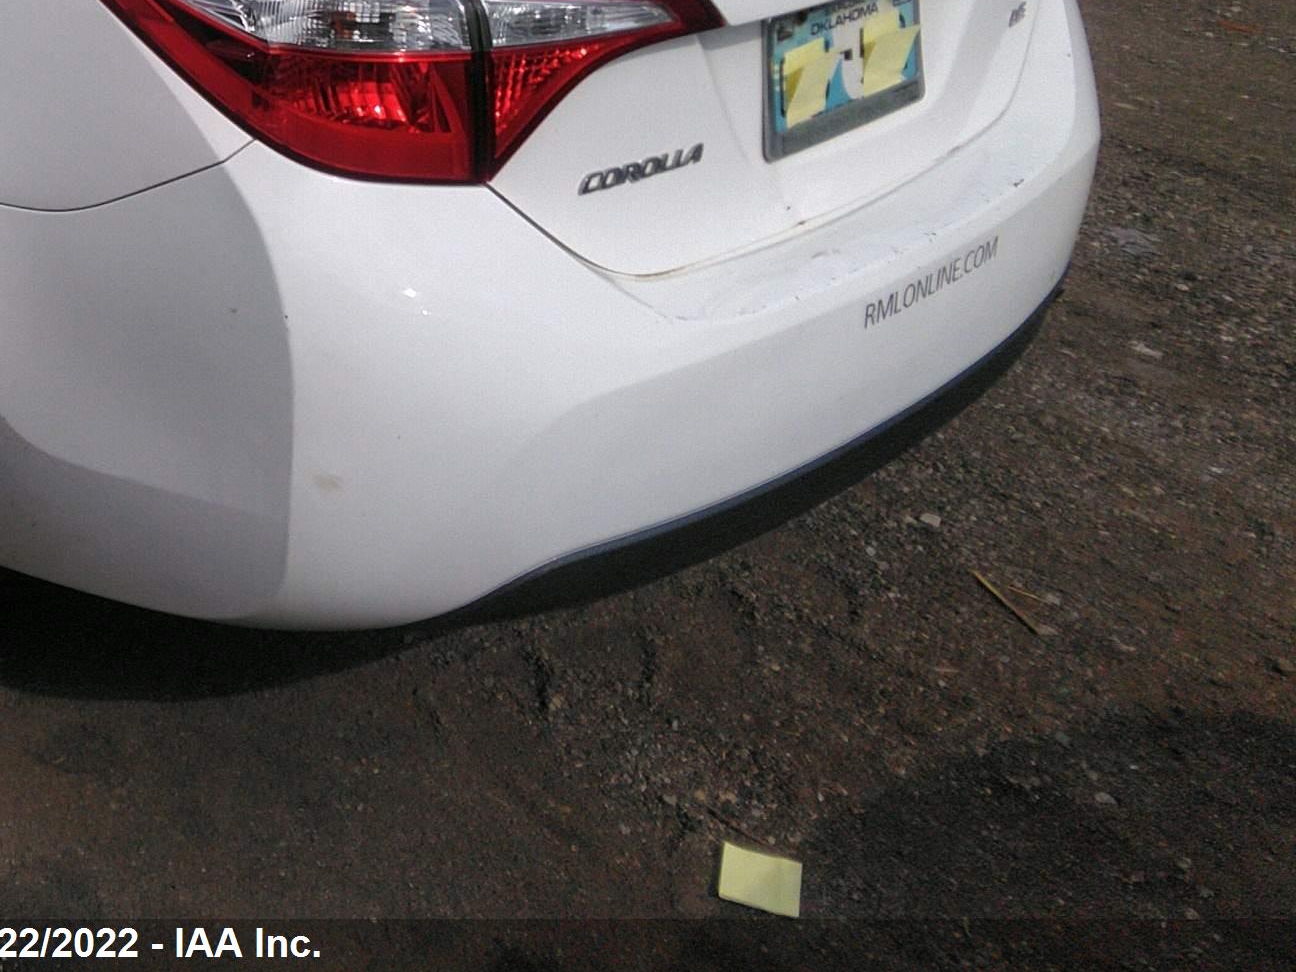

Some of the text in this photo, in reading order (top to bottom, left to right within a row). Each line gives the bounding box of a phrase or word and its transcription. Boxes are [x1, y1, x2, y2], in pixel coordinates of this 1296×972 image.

[810, 2, 879, 36] OKLAHOMA
[577, 142, 704, 196] COROLLA
[864, 235, 999, 329] RMLONLINE.COM
